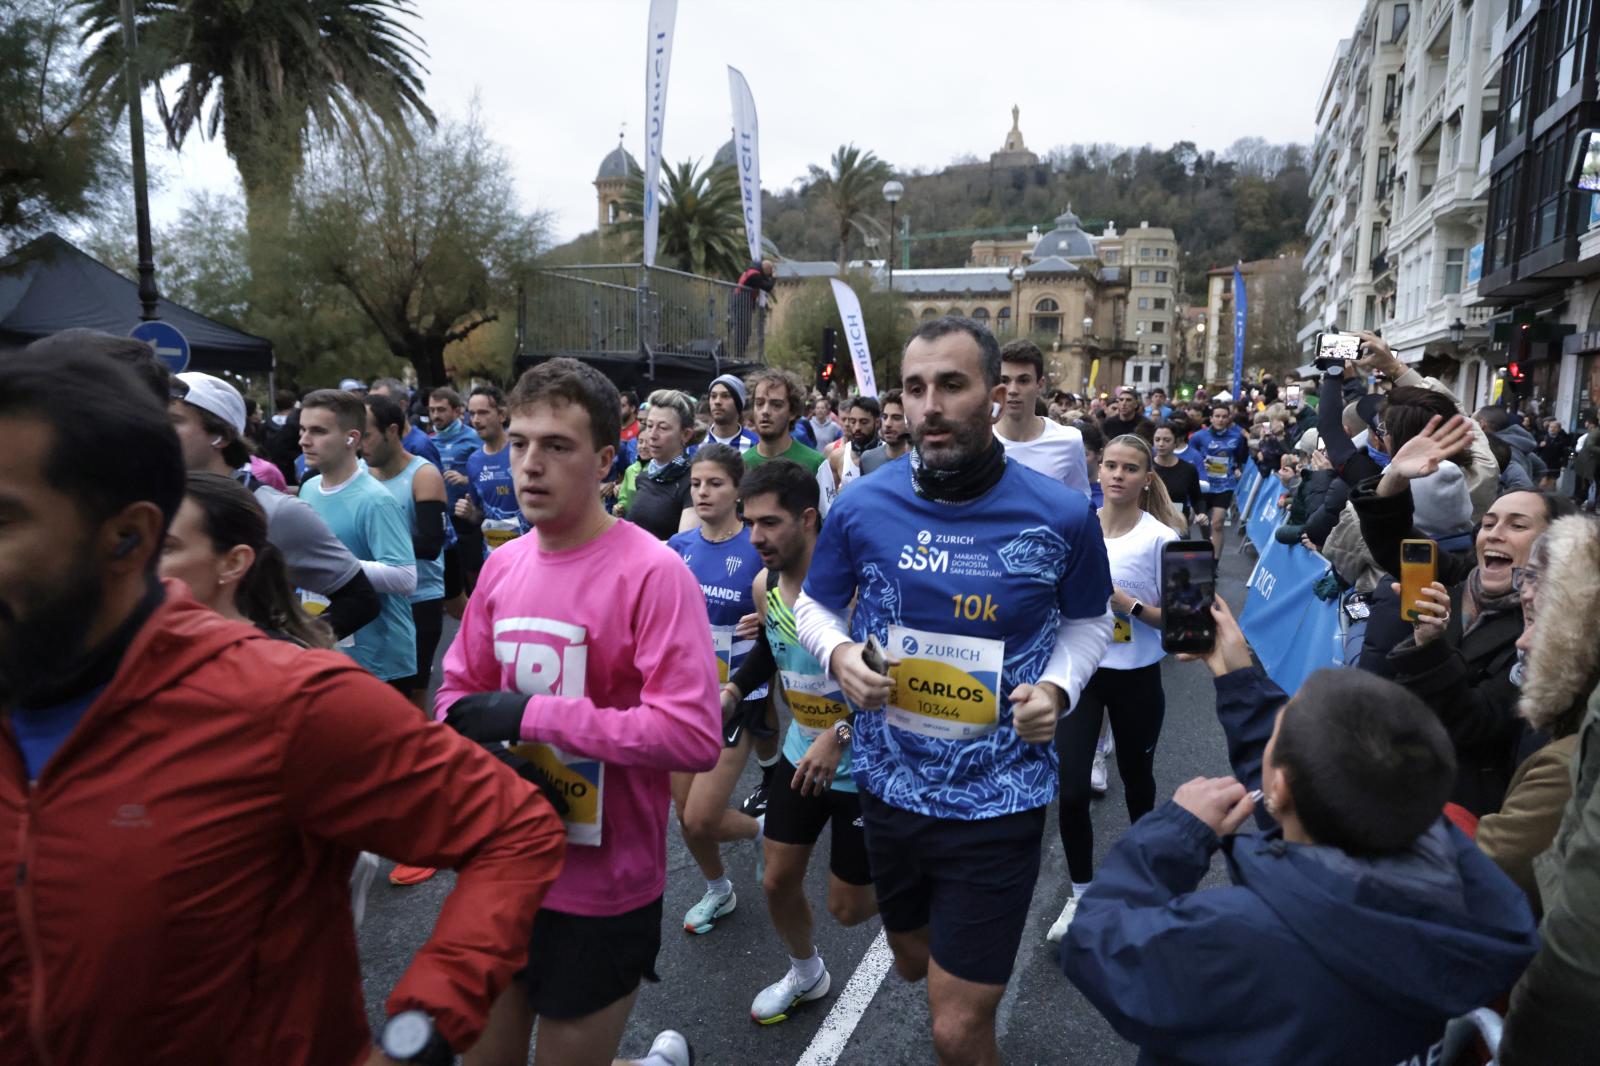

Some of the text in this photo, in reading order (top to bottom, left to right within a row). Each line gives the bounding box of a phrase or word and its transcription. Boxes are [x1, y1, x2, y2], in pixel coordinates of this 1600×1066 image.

[935, 535, 975, 545] ZURICH
[898, 545, 949, 573] SSM
[951, 560, 988, 569] DONOSTIA
[954, 553, 989, 561] MARATÓN
[950, 567, 1002, 577] SAN SEBASTIÁN
[952, 594, 999, 621] 10k
[924, 643, 981, 661] ZURICH
[908, 677, 984, 703] CARLOS
[918, 699, 960, 718] 10344
